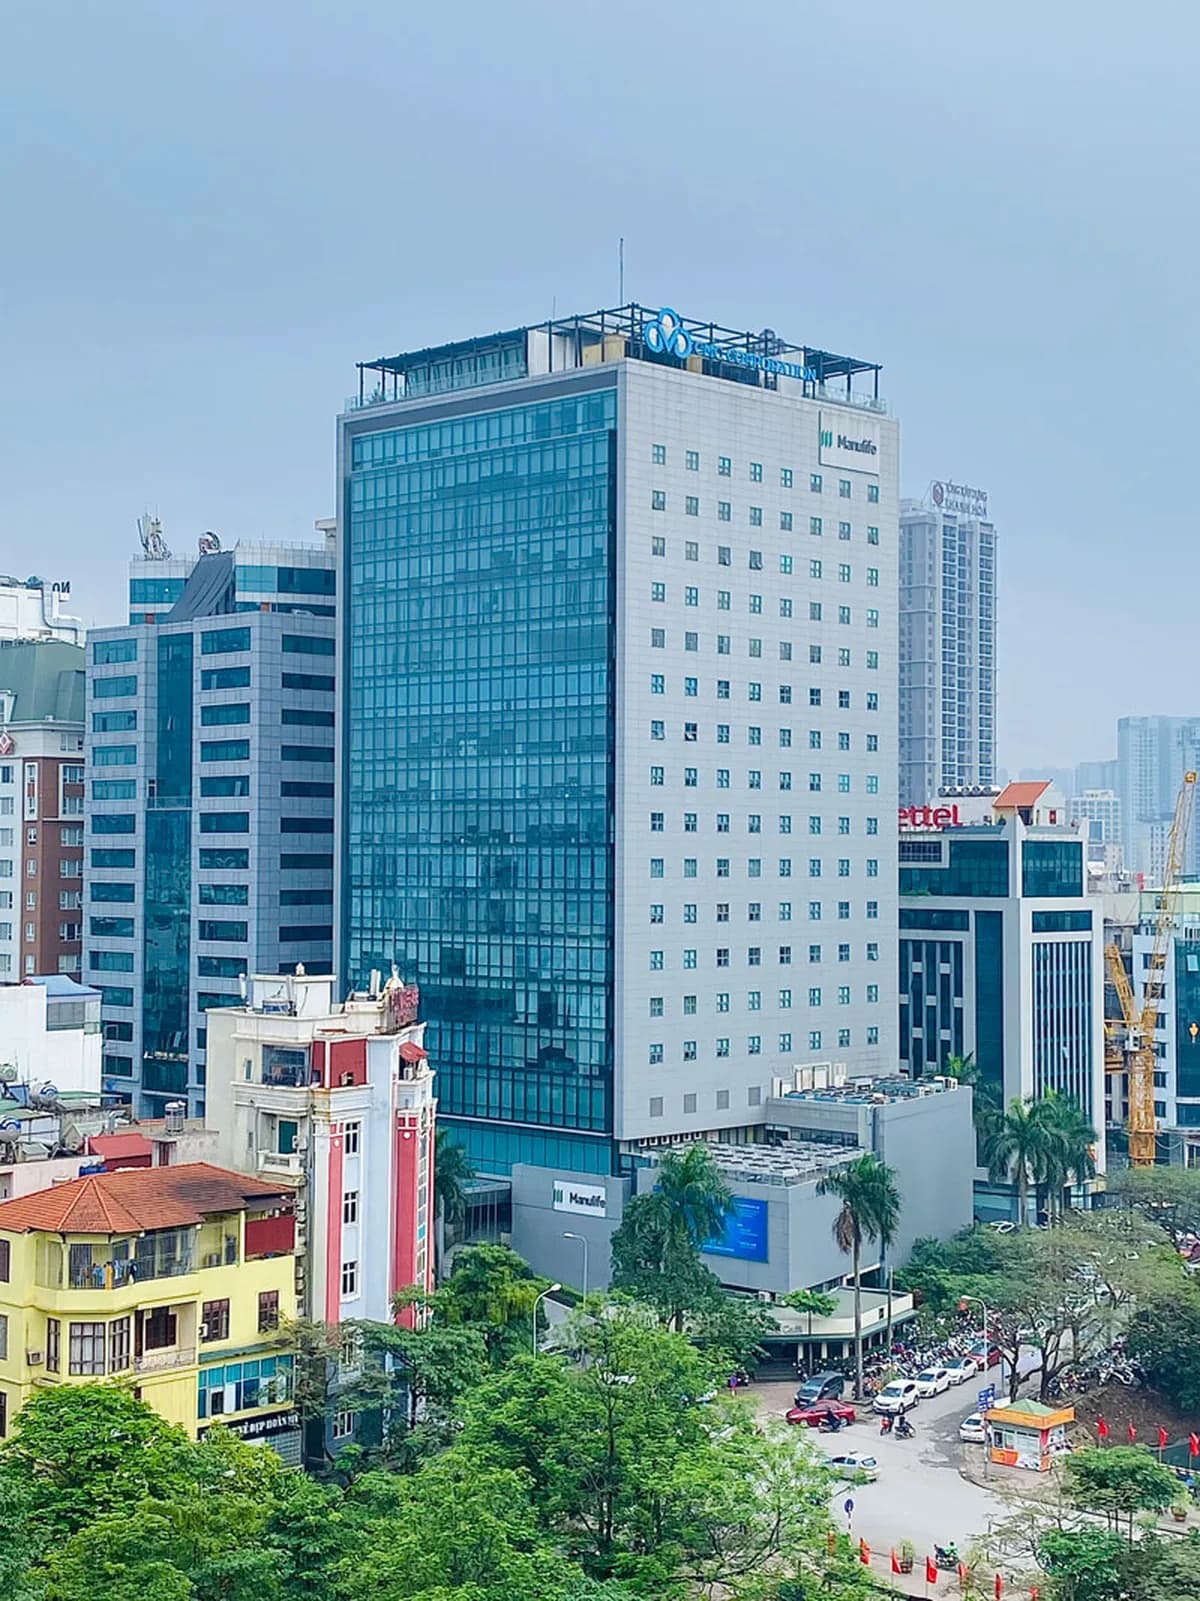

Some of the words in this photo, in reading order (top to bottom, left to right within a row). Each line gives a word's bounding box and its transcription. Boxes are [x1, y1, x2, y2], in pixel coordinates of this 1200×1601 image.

[727, 349, 816, 381] CORPORATION
[837, 434, 877, 455] Manulife
[569, 1191, 607, 1208] Manulife
